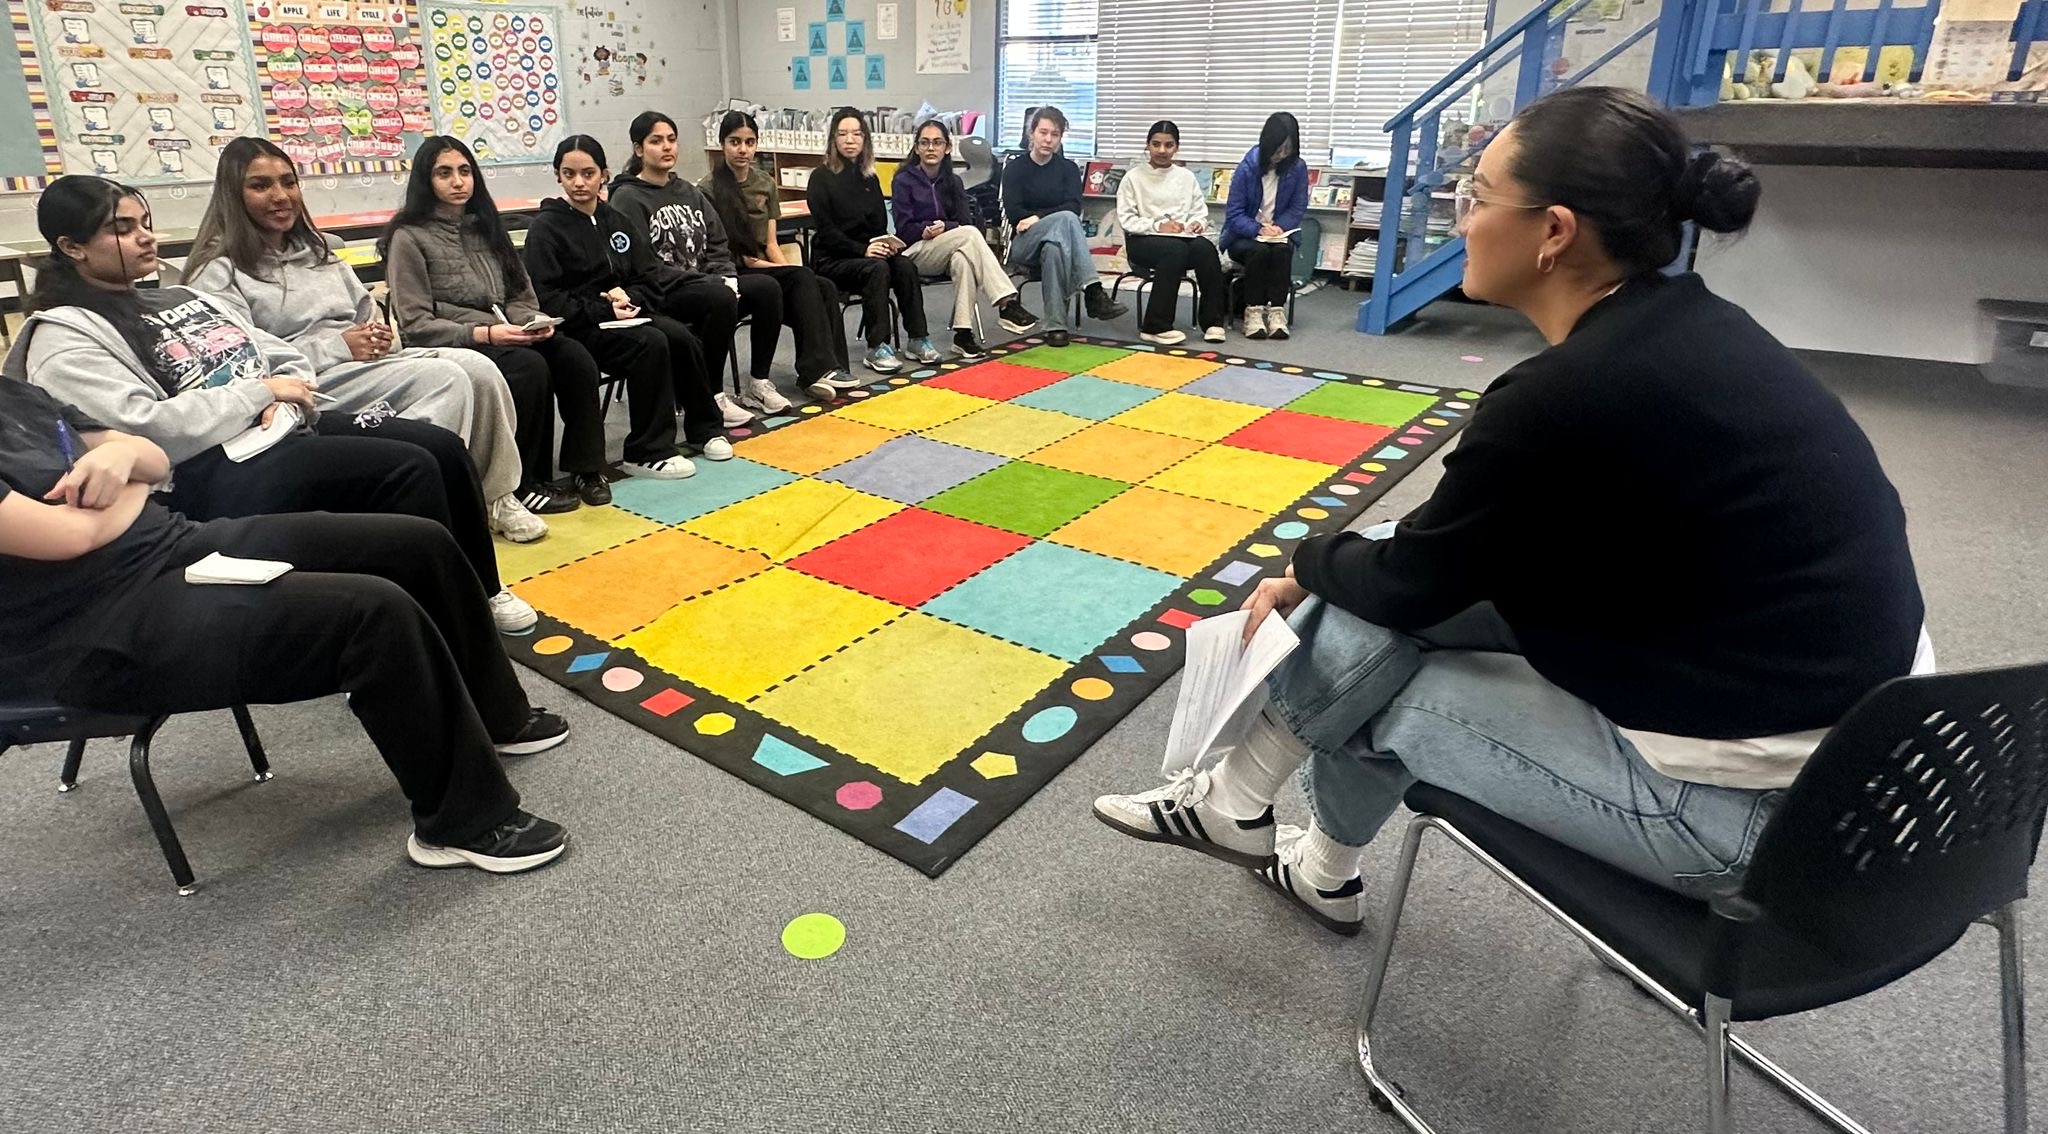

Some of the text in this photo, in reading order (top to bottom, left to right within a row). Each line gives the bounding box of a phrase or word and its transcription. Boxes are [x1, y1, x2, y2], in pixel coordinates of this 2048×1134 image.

[283, 7, 380, 19] APPLE LIFE CYCLE
